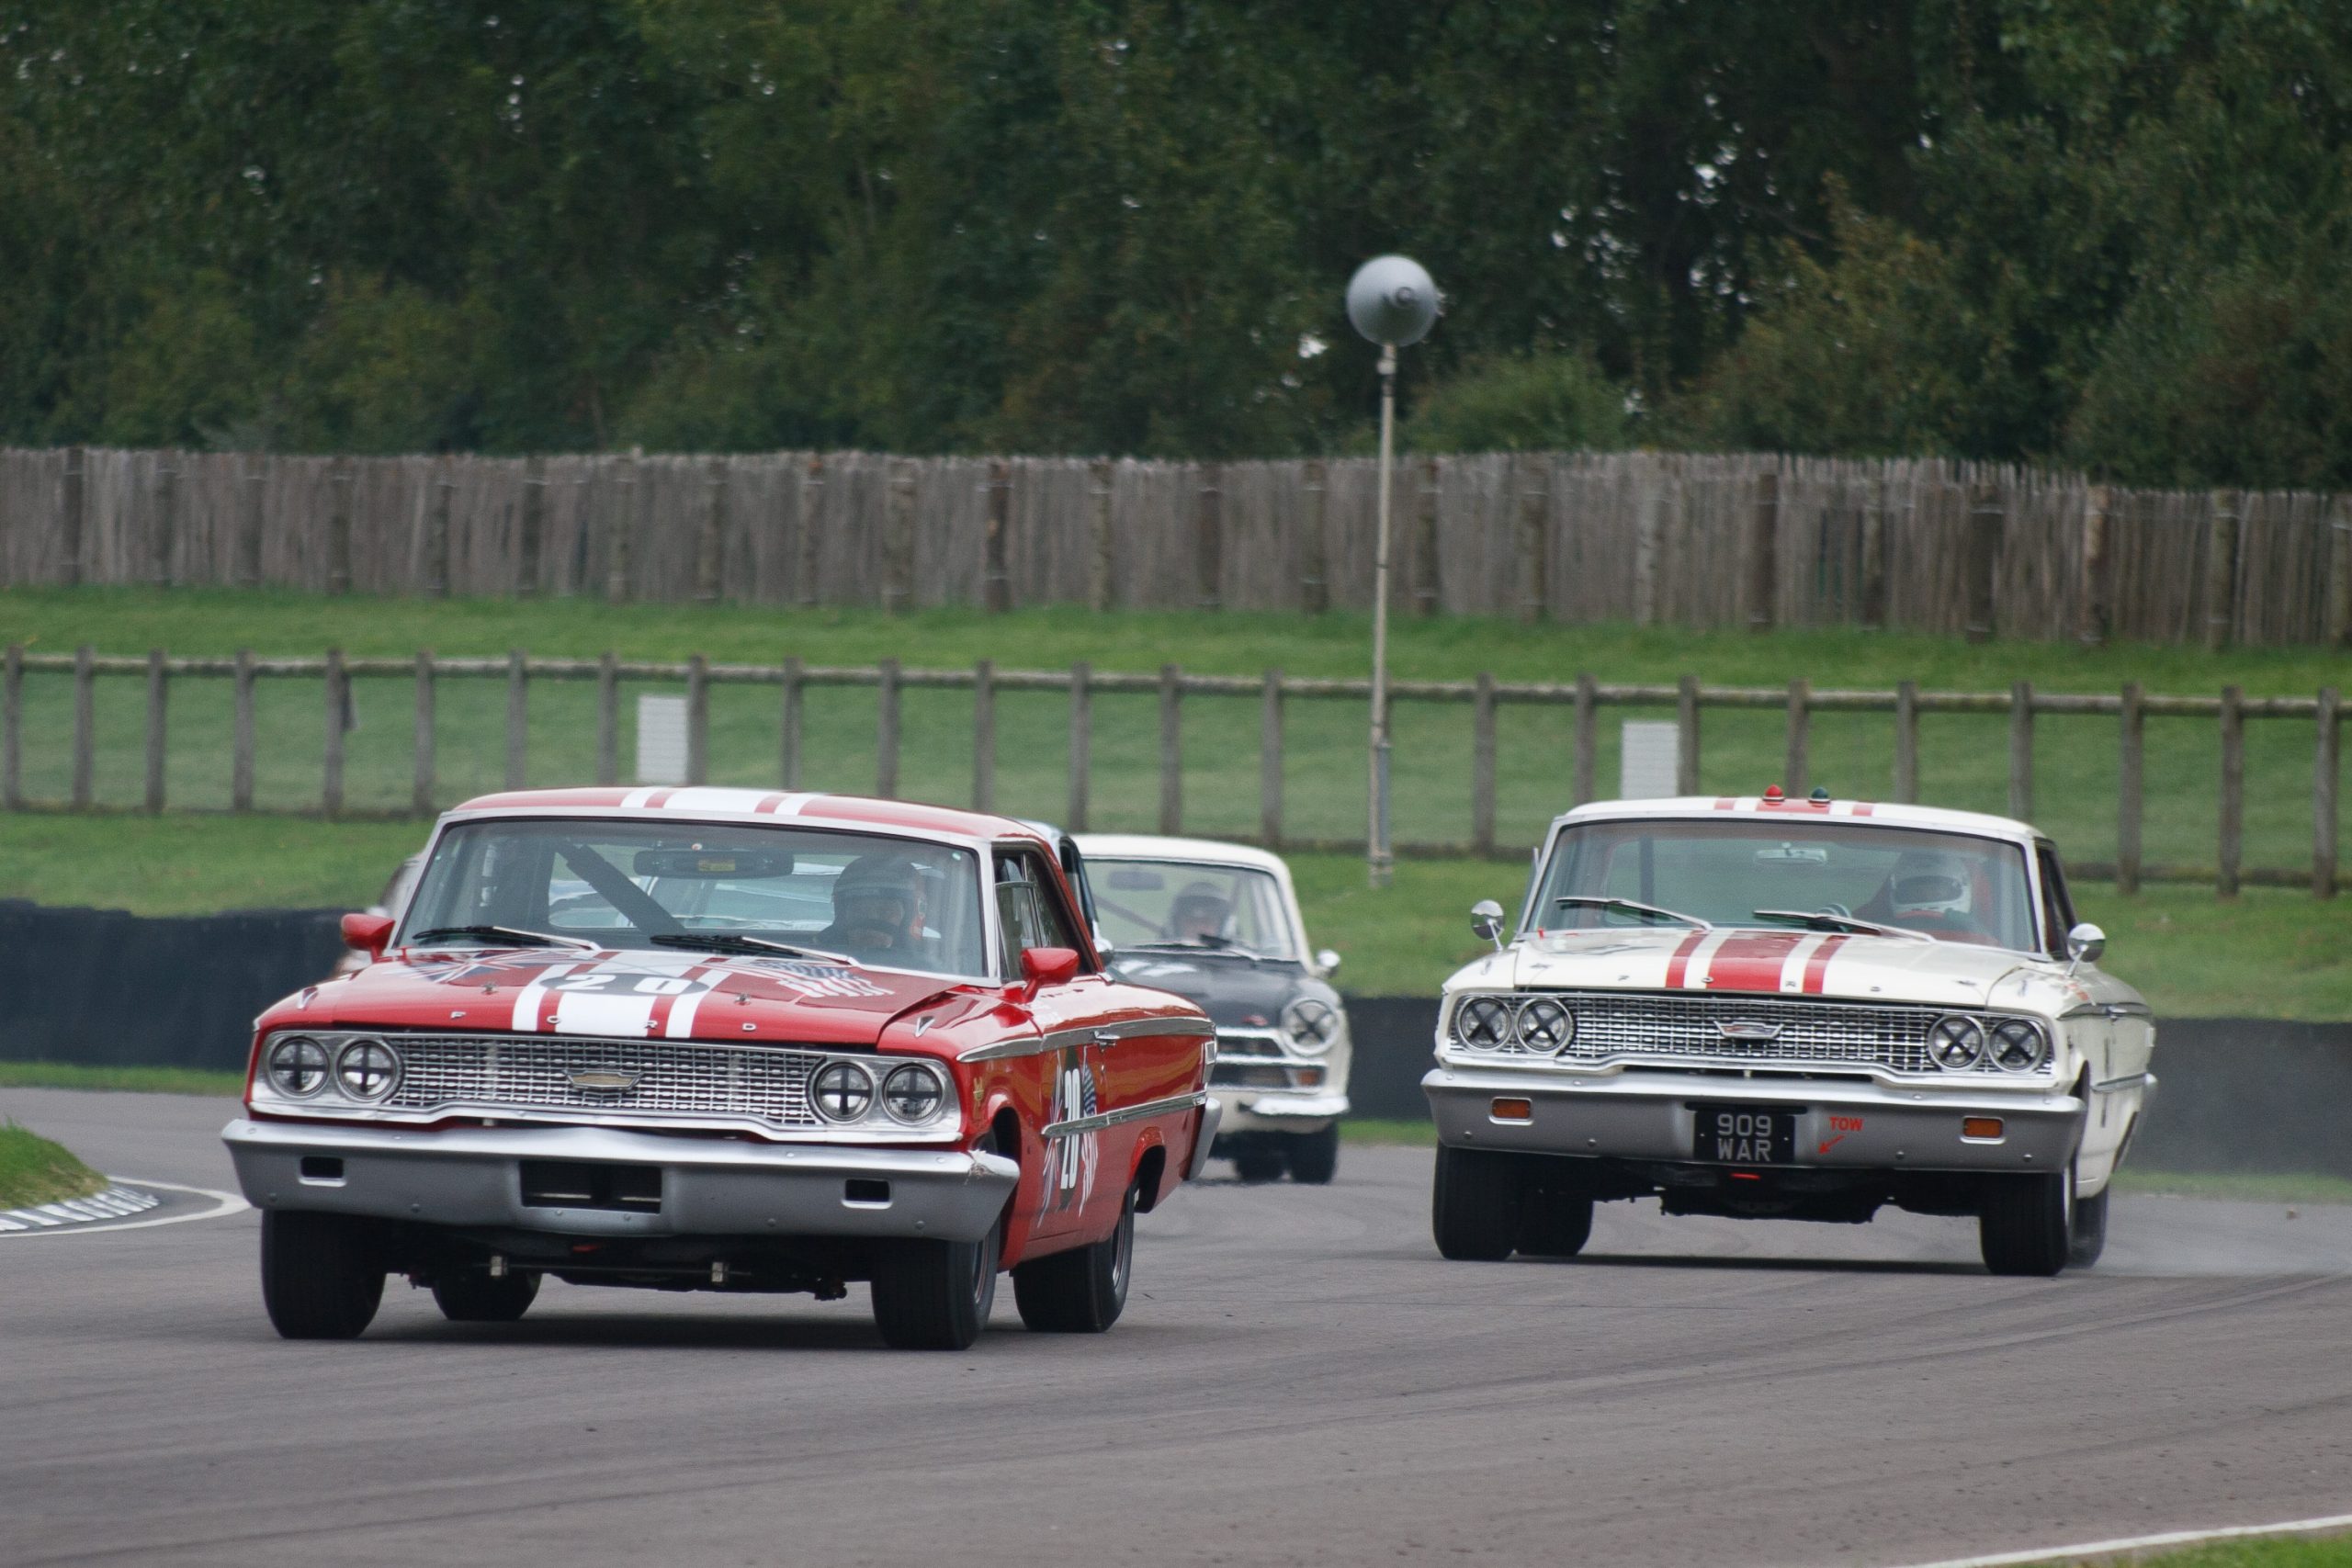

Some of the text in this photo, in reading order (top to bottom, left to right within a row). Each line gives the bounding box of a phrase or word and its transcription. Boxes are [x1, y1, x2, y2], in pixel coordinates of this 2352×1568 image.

[555, 974, 693, 994] 20
[1717, 1113, 1772, 1137] 909
[1830, 1116, 1864, 1131] TOW
[1717, 1138, 1772, 1162] WAR
